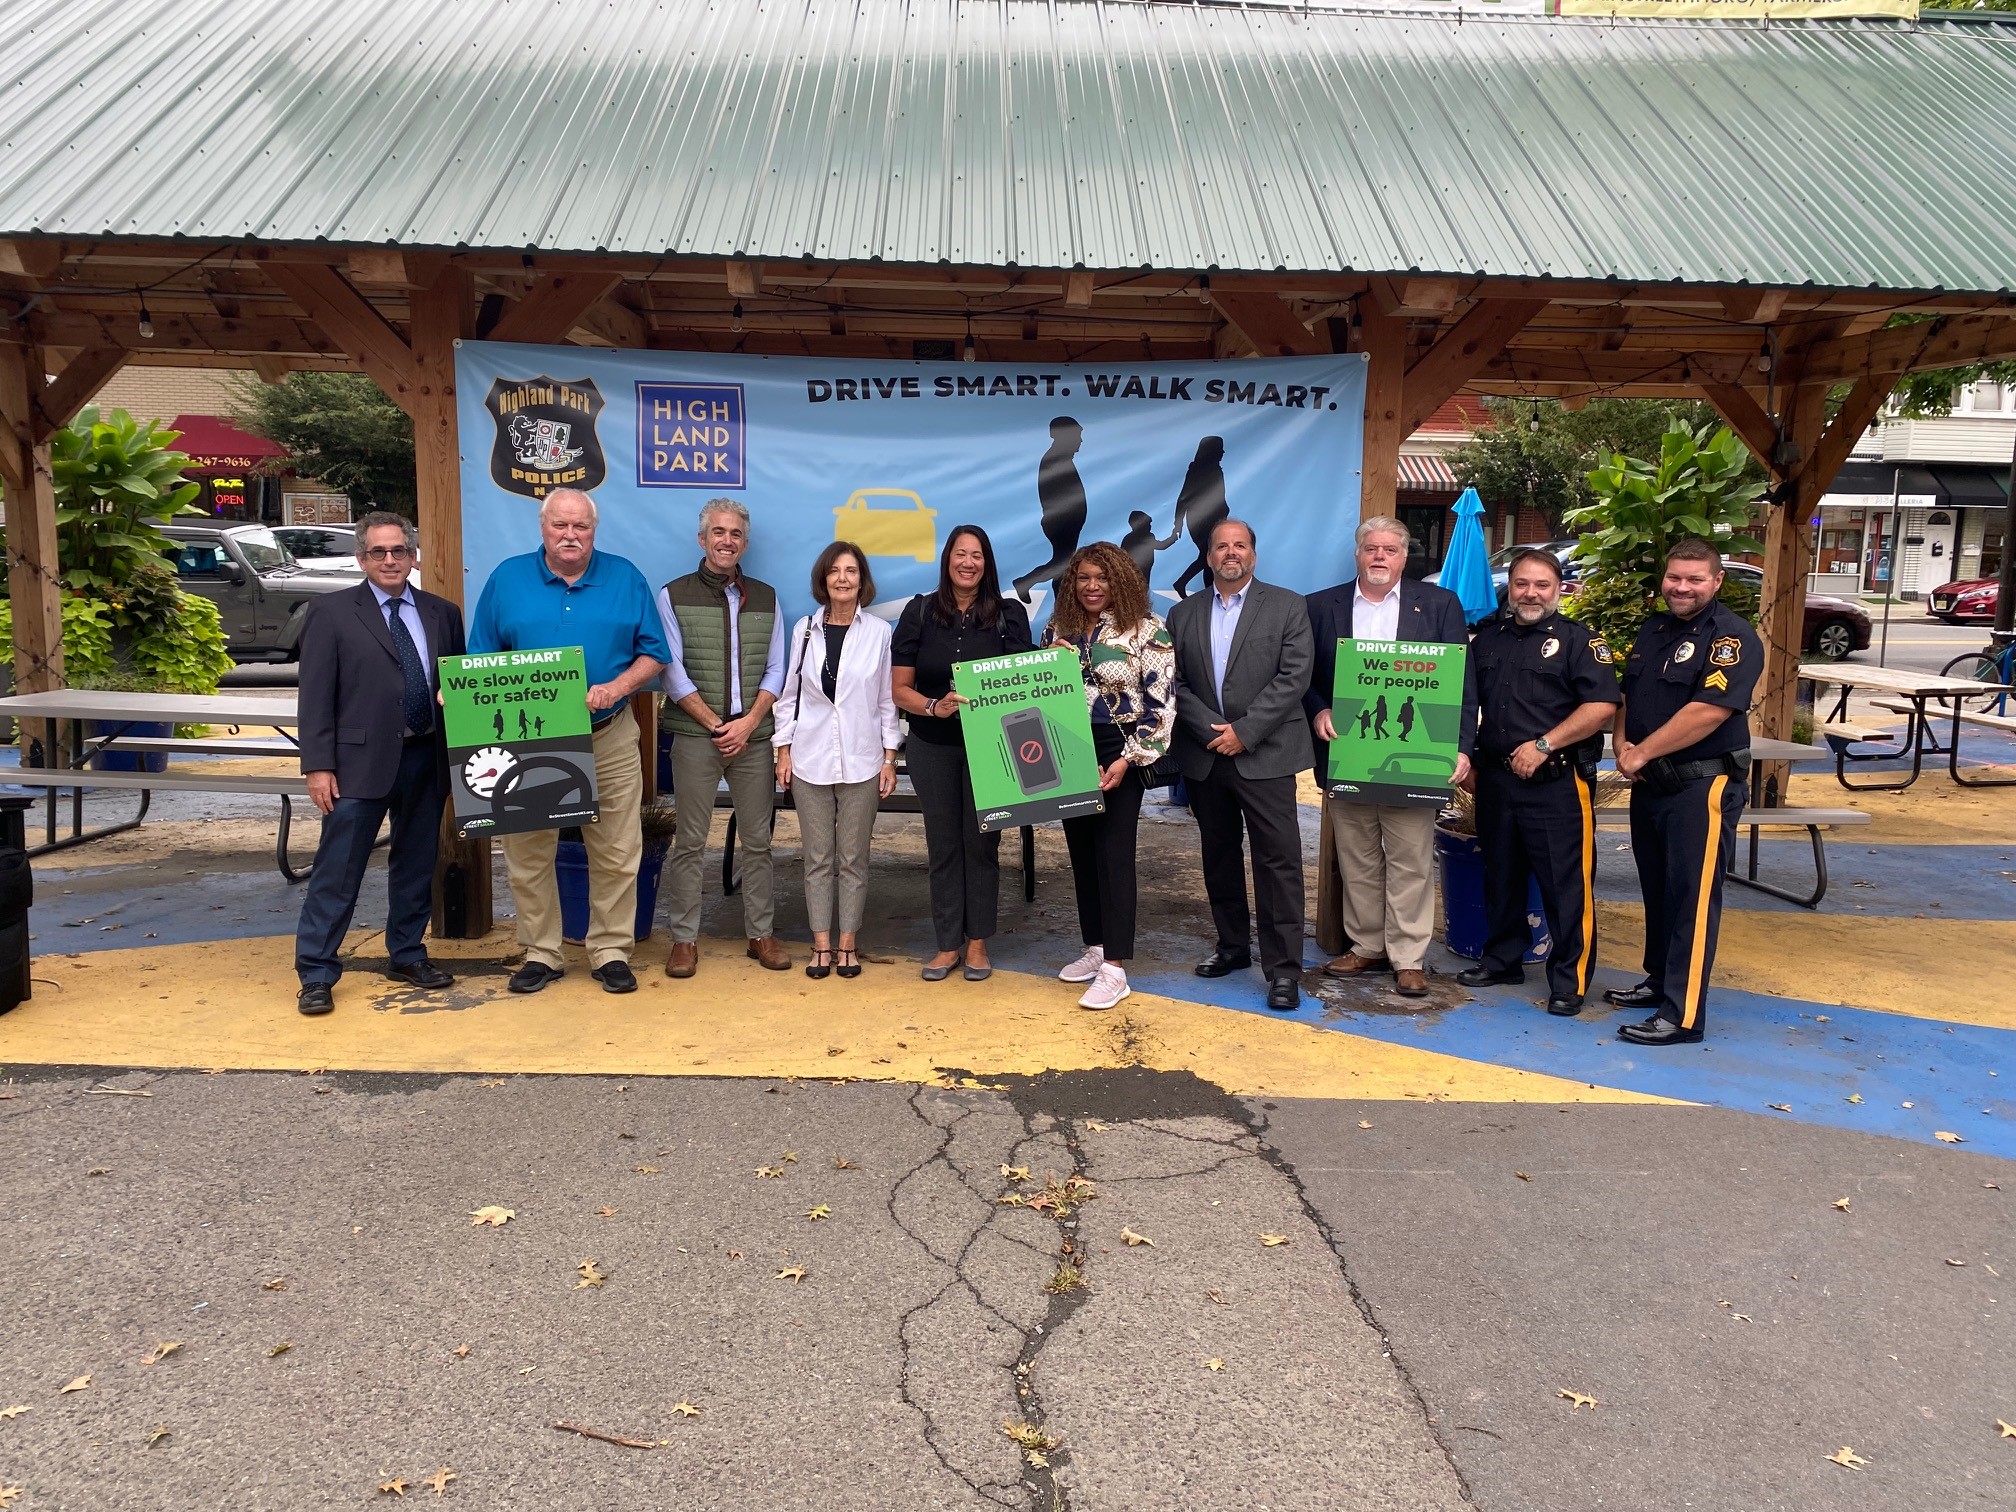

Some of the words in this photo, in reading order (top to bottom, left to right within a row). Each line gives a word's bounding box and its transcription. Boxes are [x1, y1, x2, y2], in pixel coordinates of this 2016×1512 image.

[499, 384, 554, 415] Highland
[561, 385, 590, 414] Park
[807, 377, 920, 402] DRIVE
[933, 375, 1070, 397] SMART.
[1084, 375, 1194, 400] WALK
[1204, 379, 1337, 411] SMART.
[654, 399, 729, 421] HIGH
[654, 425, 730, 447] LAND
[654, 450, 730, 473] PARK
[511, 467, 586, 484] POLICE
[215, 494, 243, 504] OPEN
[1356, 641, 1398, 654] DRIVE
[1399, 644, 1447, 656] SMART
[461, 655, 508, 670] DRIVE
[511, 650, 562, 666] SMART
[972, 658, 1013, 674] DRIVE
[1015, 651, 1059, 667] SMART
[1363, 658, 1389, 671] We
[1393, 660, 1437, 673] STOP
[447, 676, 478, 690] We
[483, 673, 524, 687] slow
[529, 669, 580, 684] down
[980, 673, 1030, 691] Heads
[1033, 670, 1058, 684] up,
[1357, 673, 1380, 685] for
[1384, 675, 1440, 691] people
[472, 691, 499, 705] for
[503, 687, 559, 703] safety
[968, 690, 1027, 712] phones
[1030, 682, 1074, 699] down
